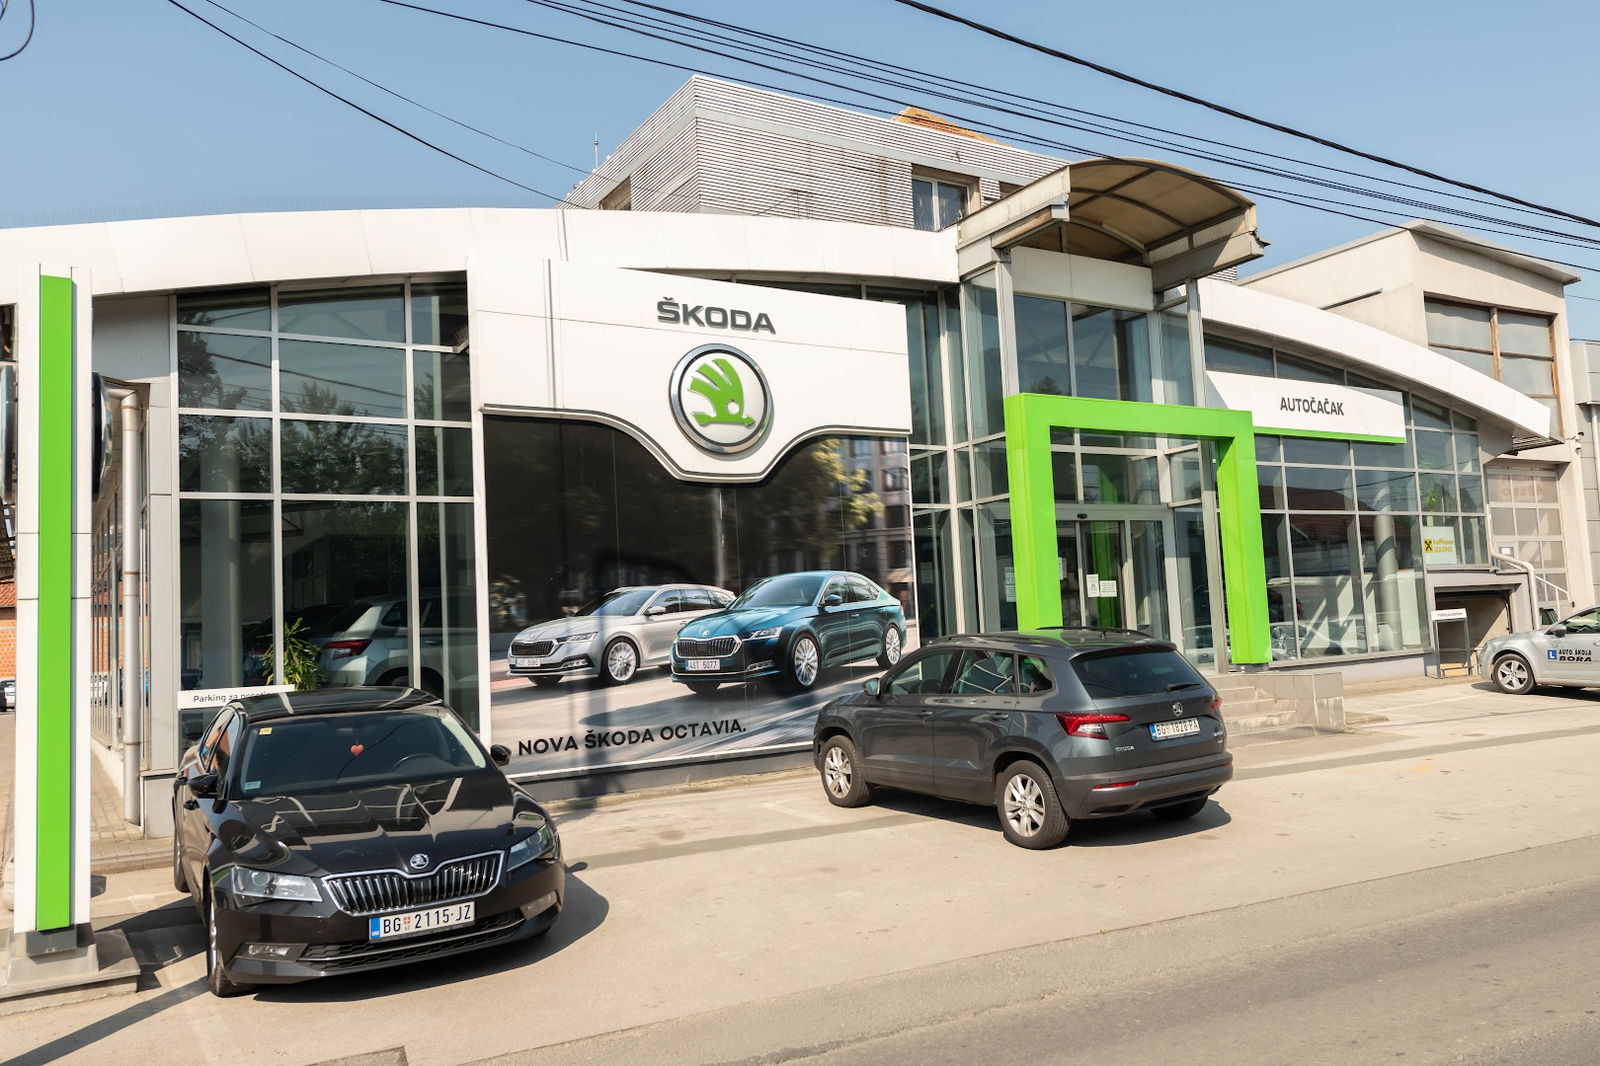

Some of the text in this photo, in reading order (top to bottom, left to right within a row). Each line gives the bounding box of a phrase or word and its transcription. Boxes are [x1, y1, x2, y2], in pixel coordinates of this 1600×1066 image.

[656, 296, 777, 335] ŠKODA
[1280, 396, 1345, 416] AUTOČAČAK
[193, 694, 226, 703] Parking
[228, 693, 239, 701] za
[518, 718, 747, 755] NOVA ŠKODA OCTAVIA.
[383, 917, 402, 934] BG
